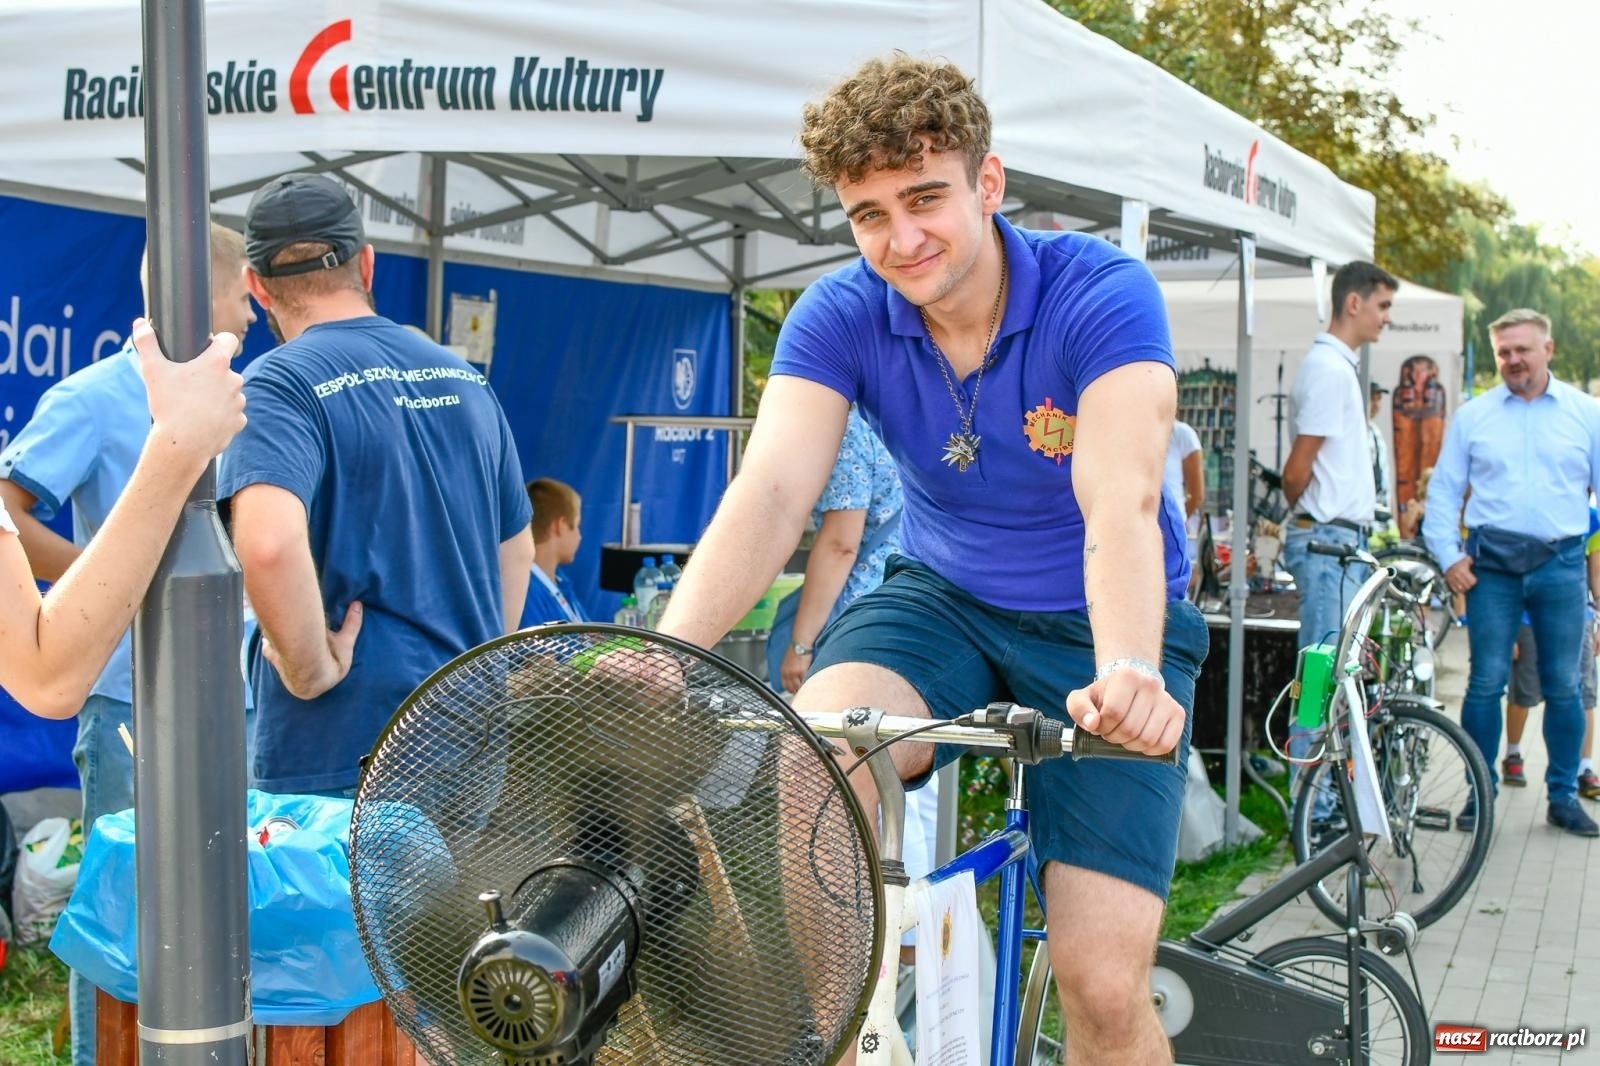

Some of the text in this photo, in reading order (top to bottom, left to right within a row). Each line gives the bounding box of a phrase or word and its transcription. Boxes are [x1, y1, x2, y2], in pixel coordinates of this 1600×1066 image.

[509, 56, 664, 123] Kultury
[313, 372, 365, 399] ZESPÓŁ
[1041, 439, 1074, 452] RACIBÓ
